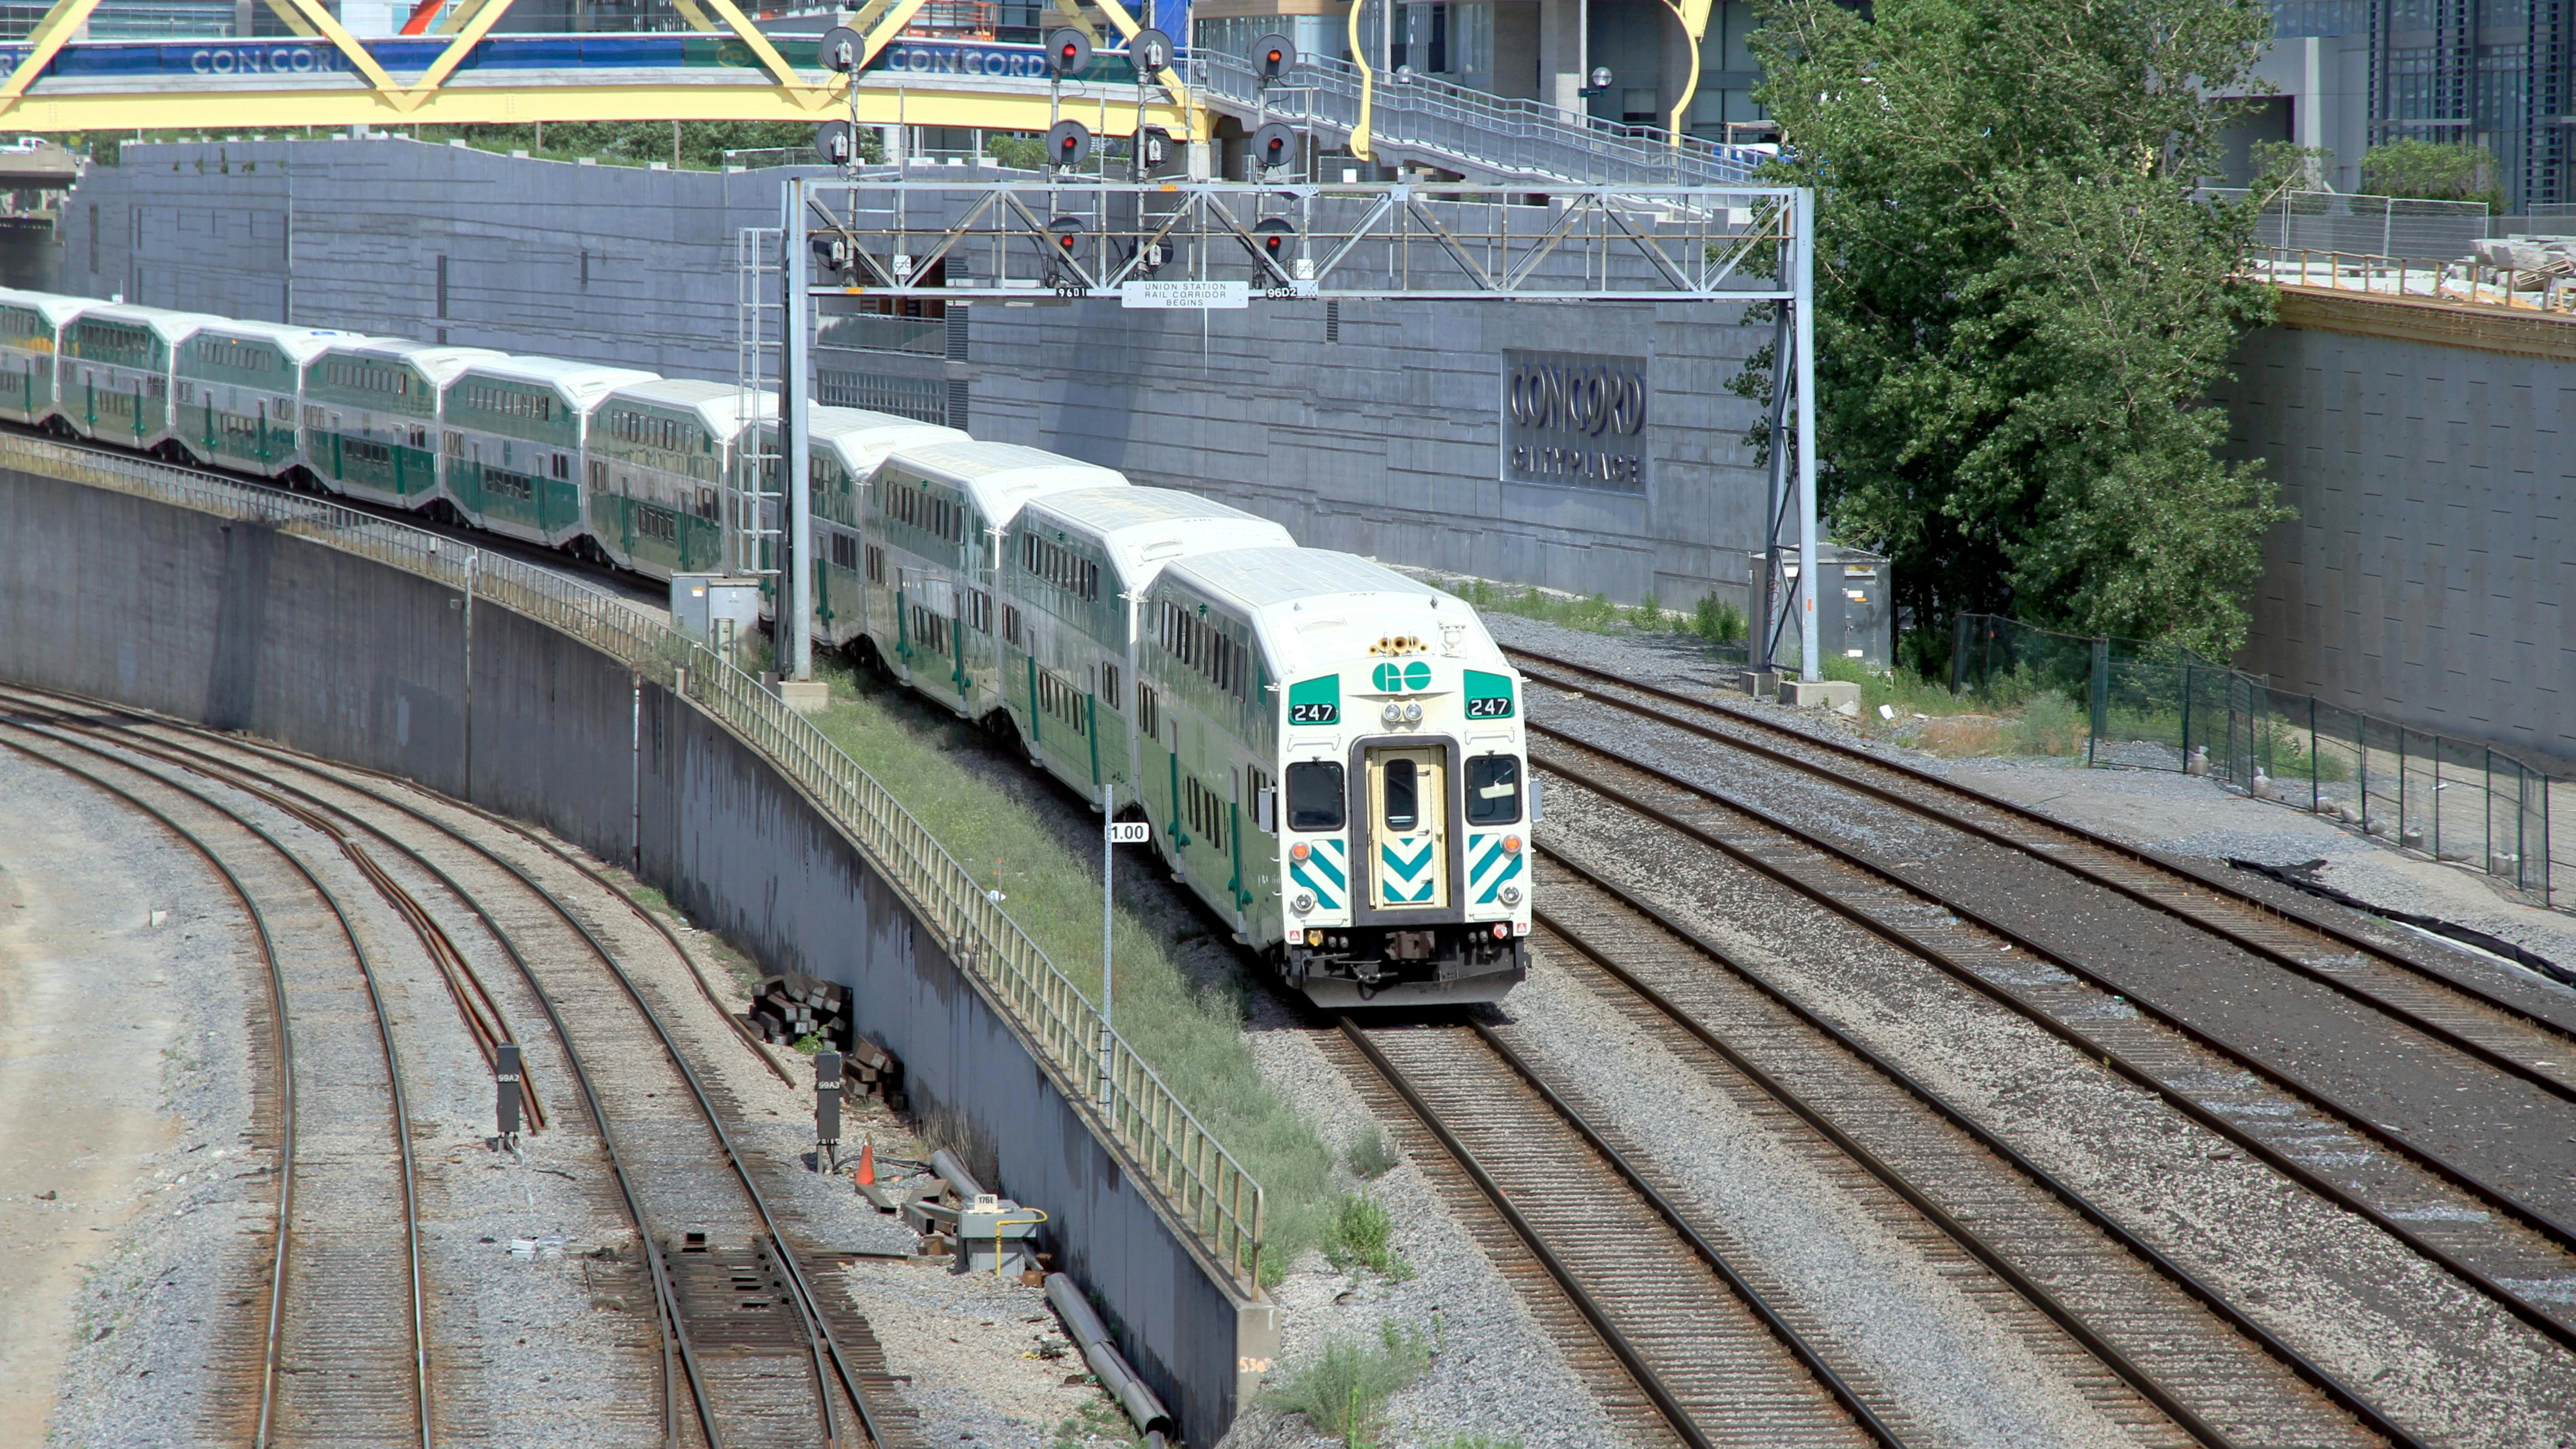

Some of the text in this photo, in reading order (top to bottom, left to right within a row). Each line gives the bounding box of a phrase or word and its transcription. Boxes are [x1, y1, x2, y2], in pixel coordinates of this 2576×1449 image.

[889, 48, 1046, 77] CONCORD
[1268, 287, 1297, 298] 96D2
[1511, 364, 1643, 436] CONCORD
[1513, 445, 1638, 483] CITYPLACE
[1372, 661, 1432, 692] GO
[1294, 704, 1333, 721] 247
[1471, 698, 1508, 716] 247
[1111, 825, 1143, 839] 1.00
